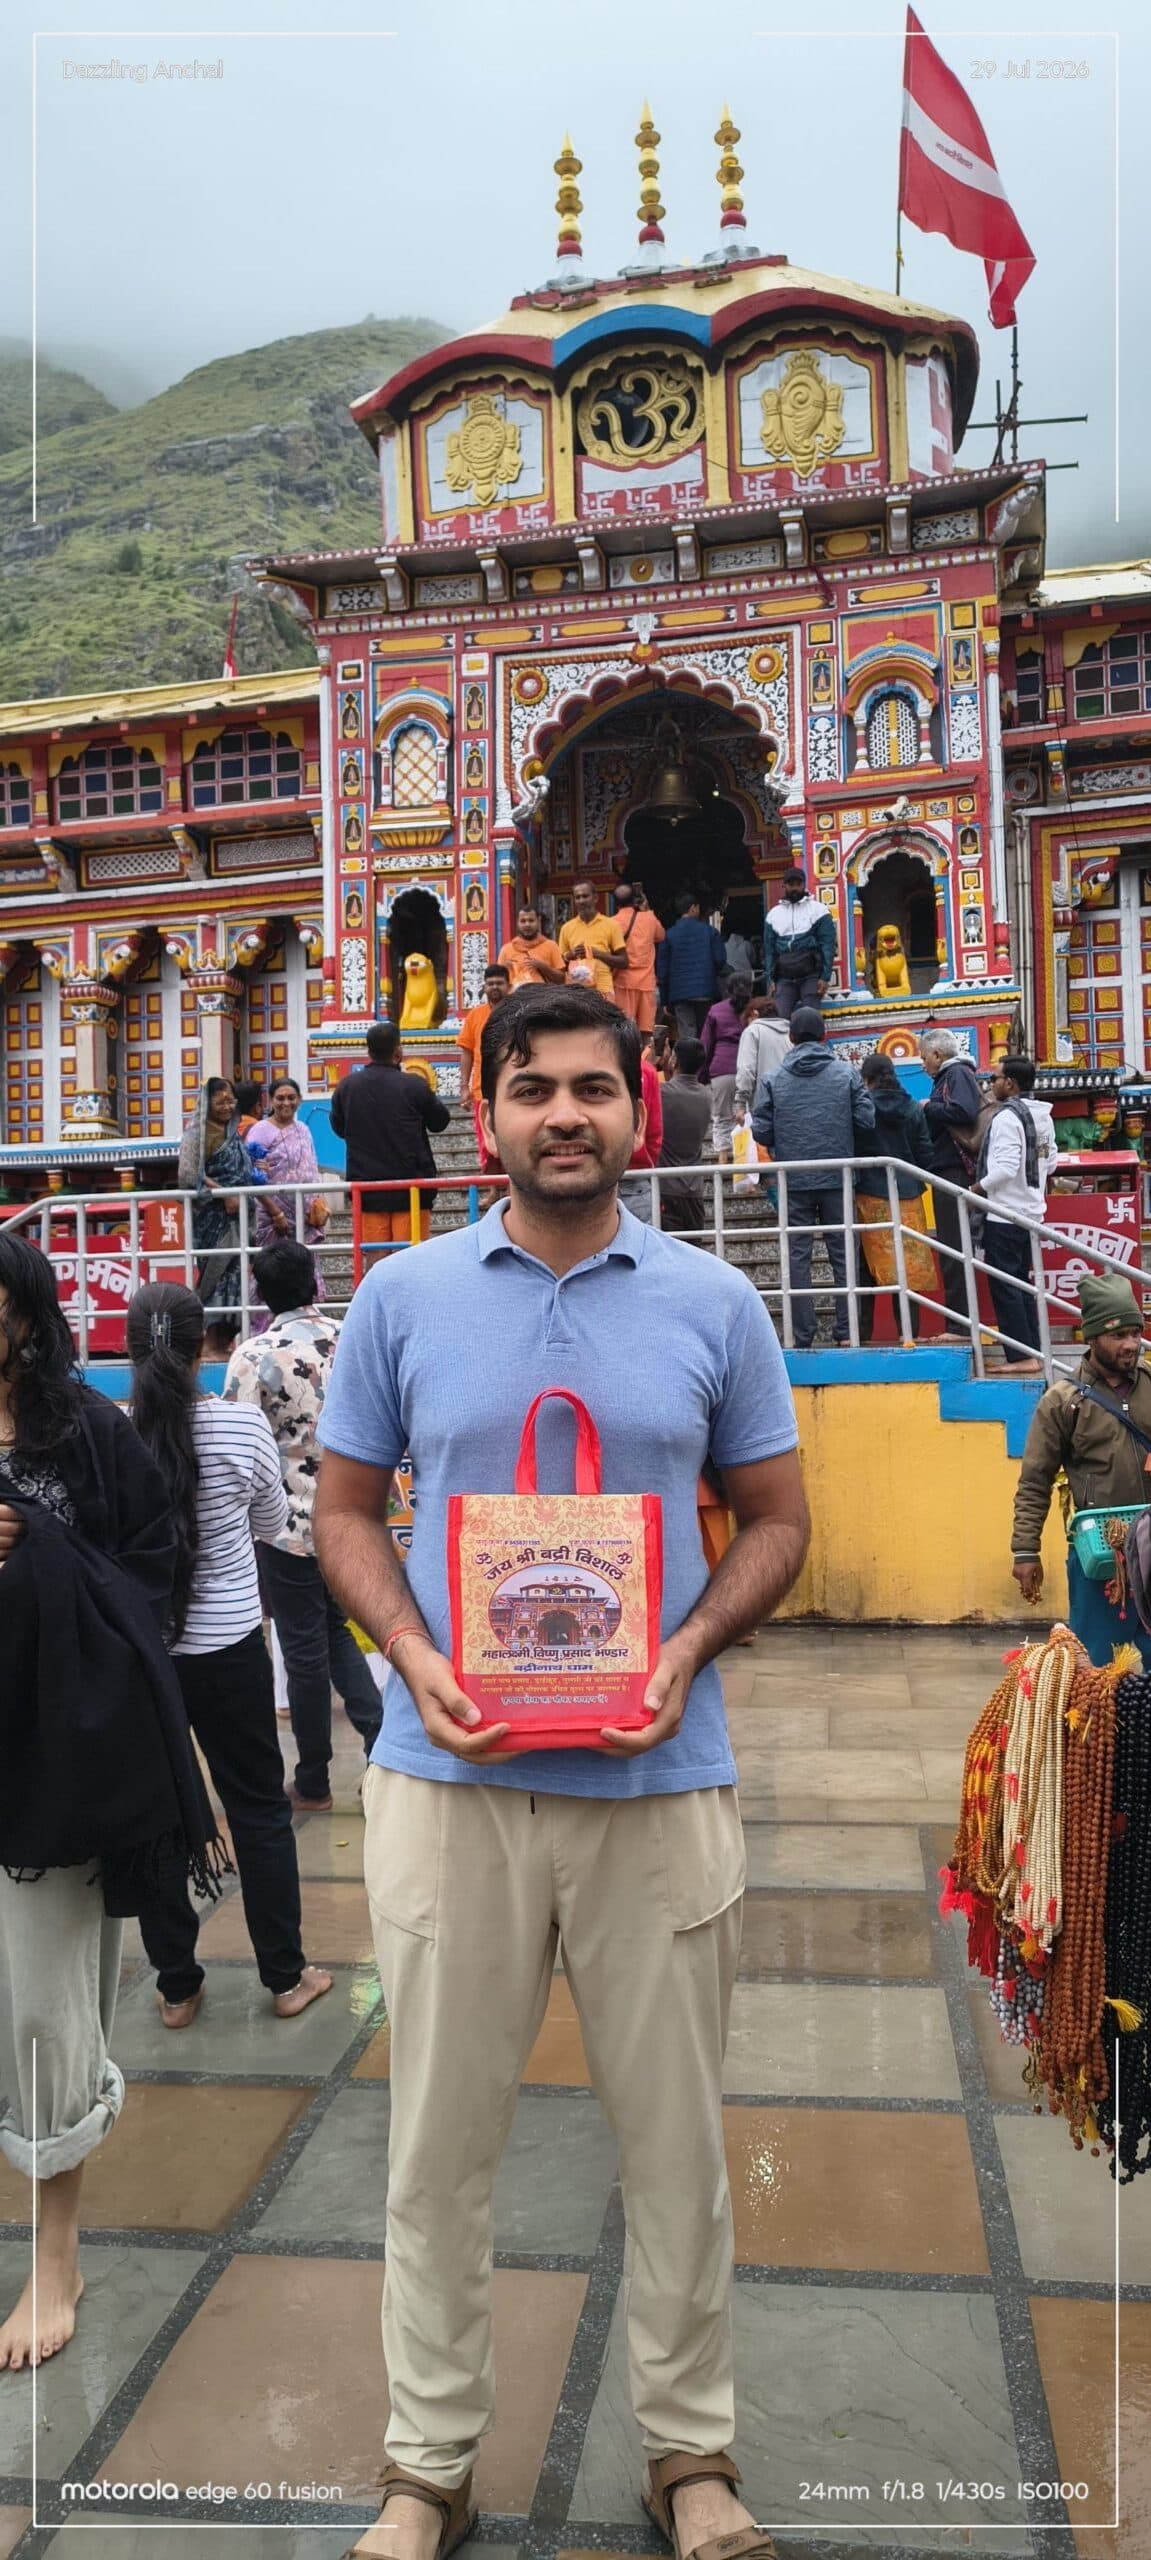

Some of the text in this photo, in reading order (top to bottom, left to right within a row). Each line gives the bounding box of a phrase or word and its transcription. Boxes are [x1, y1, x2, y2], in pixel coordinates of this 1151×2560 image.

[483, 1559, 513, 1580] जय
[516, 1548, 535, 1564] श्री
[575, 1548, 626, 1580] विशाल
[595, 1648, 629, 1658] भण्डार
[513, 1662, 563, 1672] बद्रीनाथ
